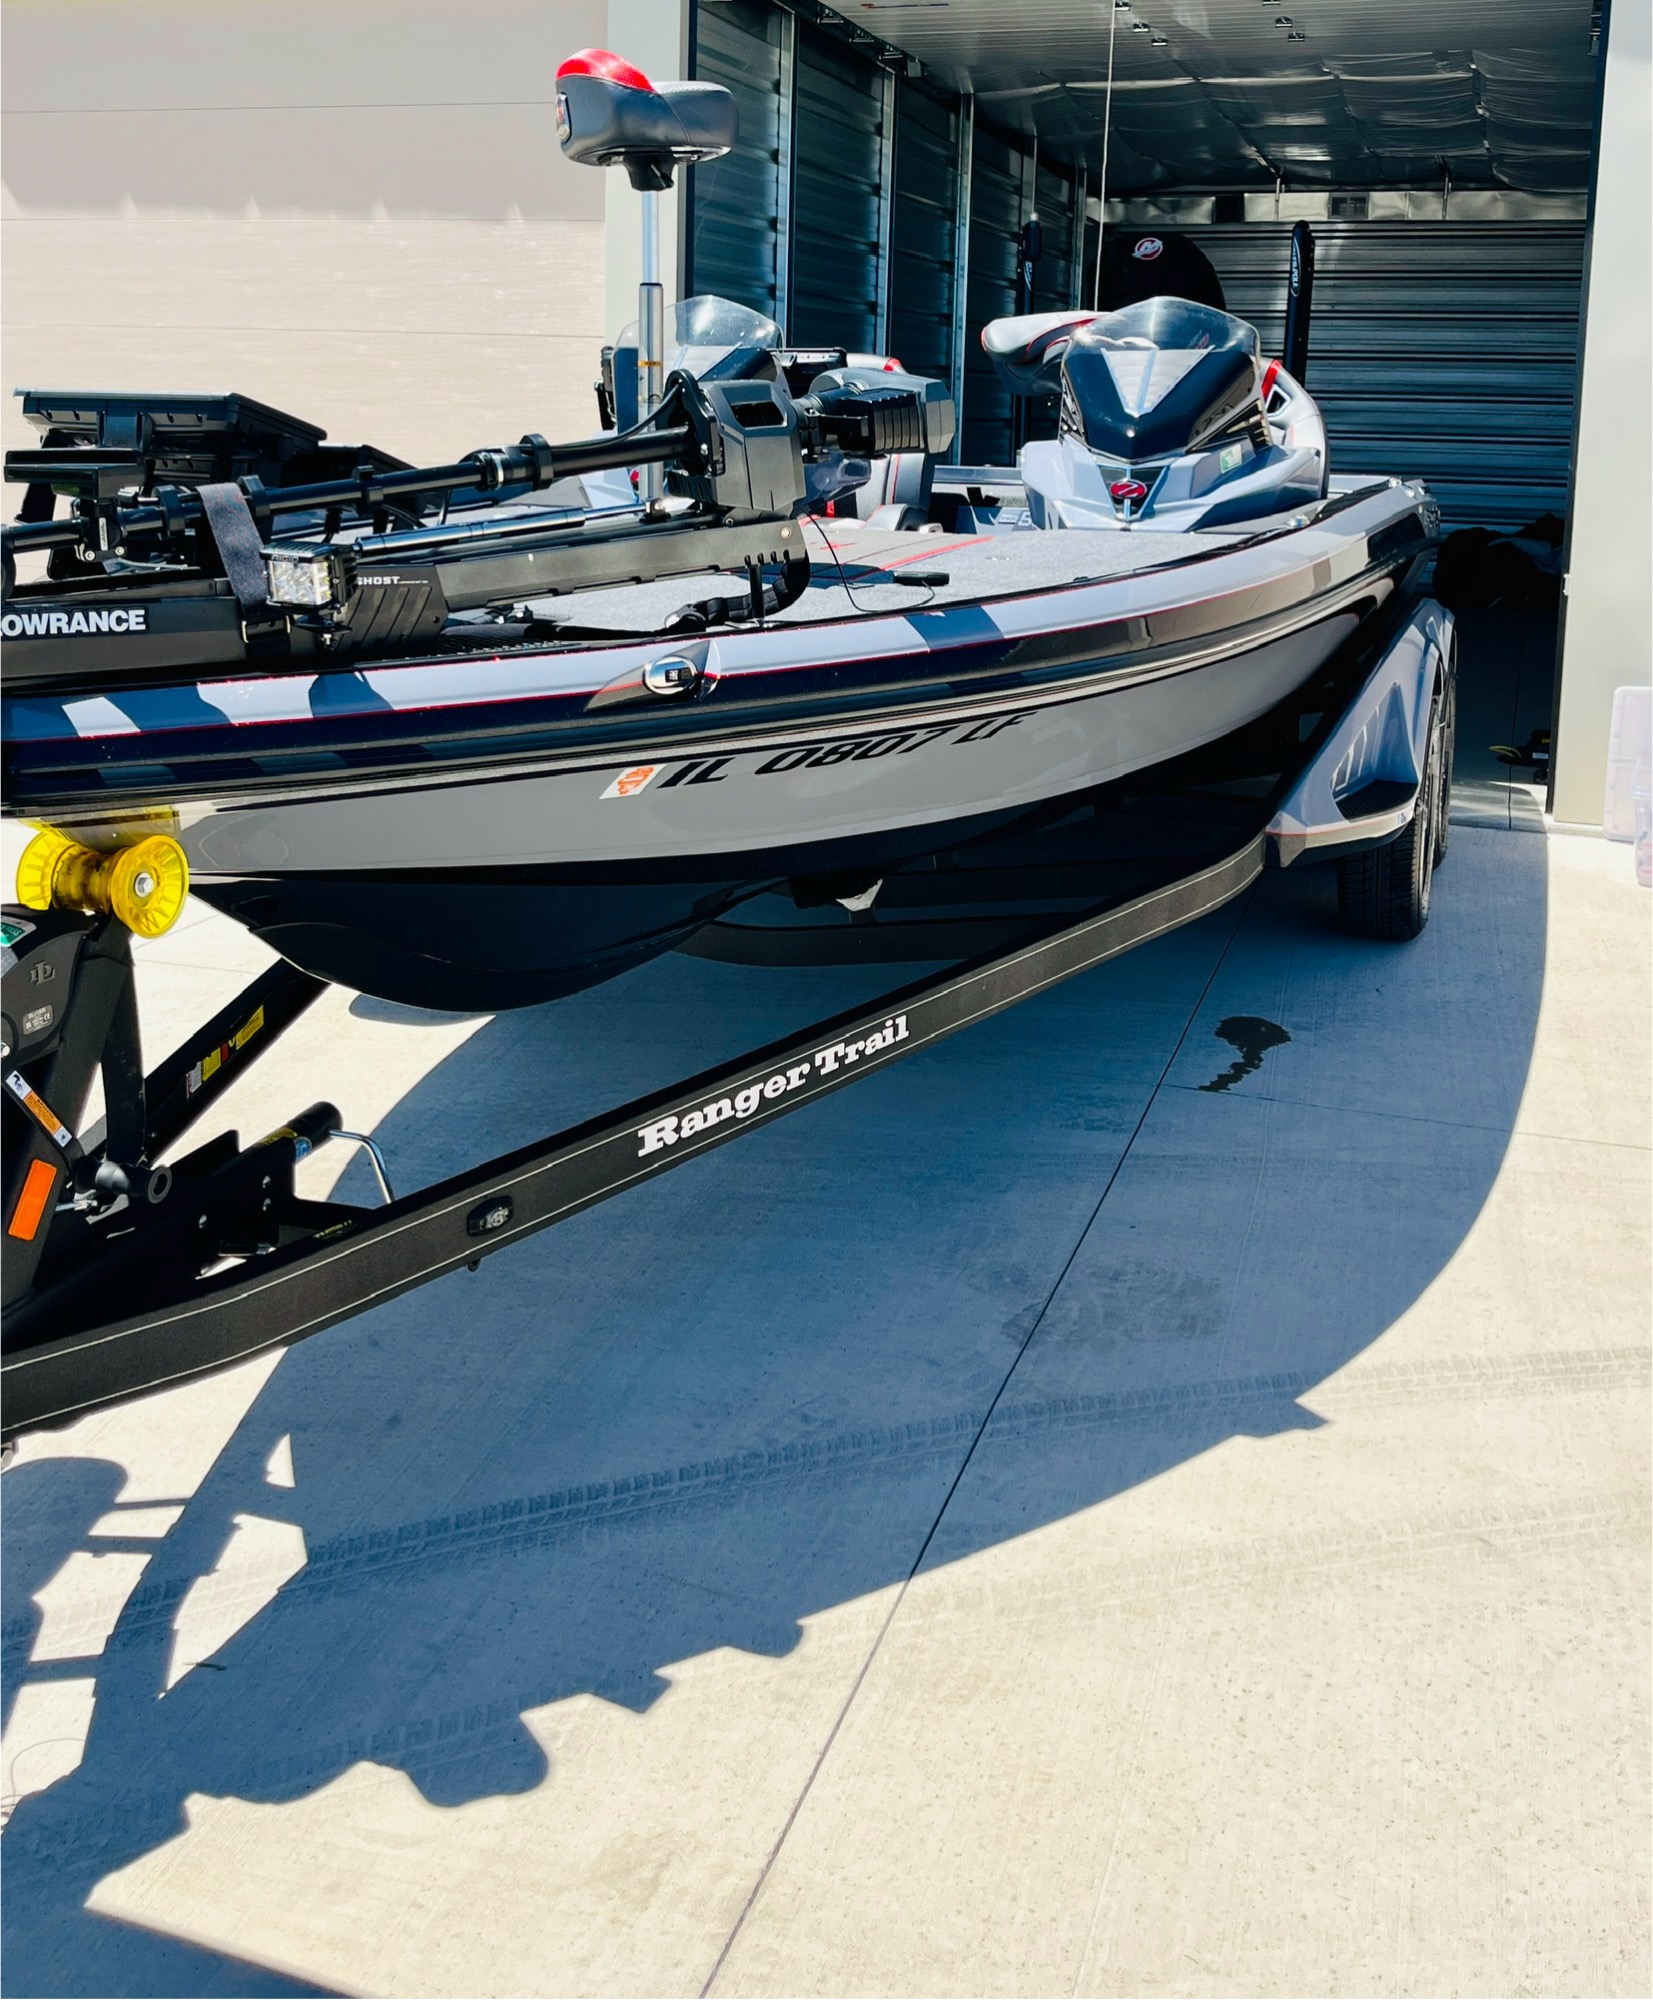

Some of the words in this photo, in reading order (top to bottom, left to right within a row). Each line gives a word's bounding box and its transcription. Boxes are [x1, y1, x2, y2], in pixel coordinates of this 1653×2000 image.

[0, 609, 146, 637] OWRANCE
[656, 756, 737, 789] IL
[754, 725, 962, 776] 0807
[949, 711, 1039, 746] LF
[637, 1062, 811, 1158] Ranger
[814, 1014, 910, 1076] Trail
